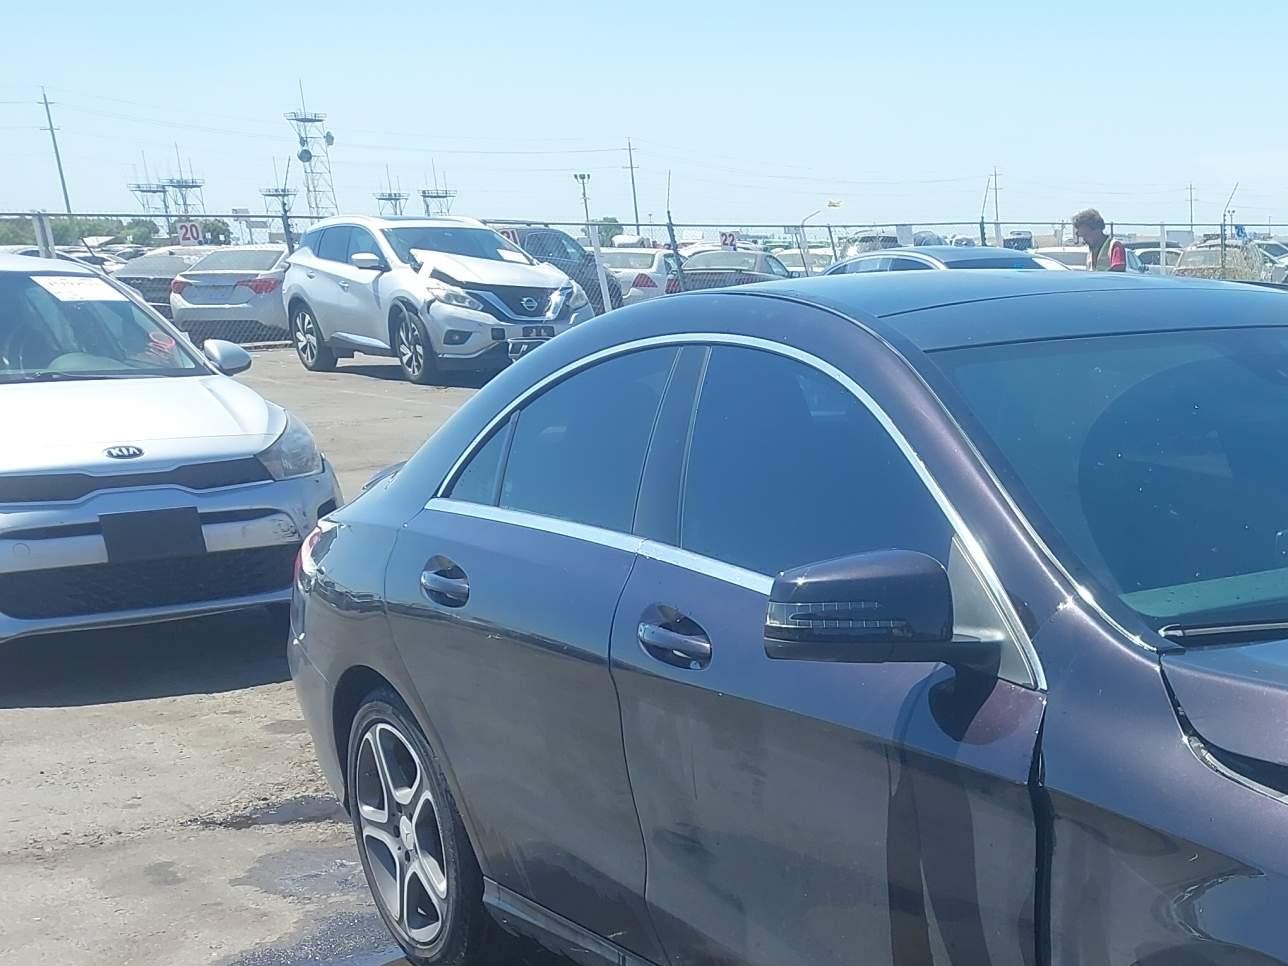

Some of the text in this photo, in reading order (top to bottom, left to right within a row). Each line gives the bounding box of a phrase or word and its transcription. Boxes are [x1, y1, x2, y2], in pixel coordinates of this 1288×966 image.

[180, 223, 200, 241] 20
[720, 232, 737, 247] 22
[107, 446, 141, 458] KIA
